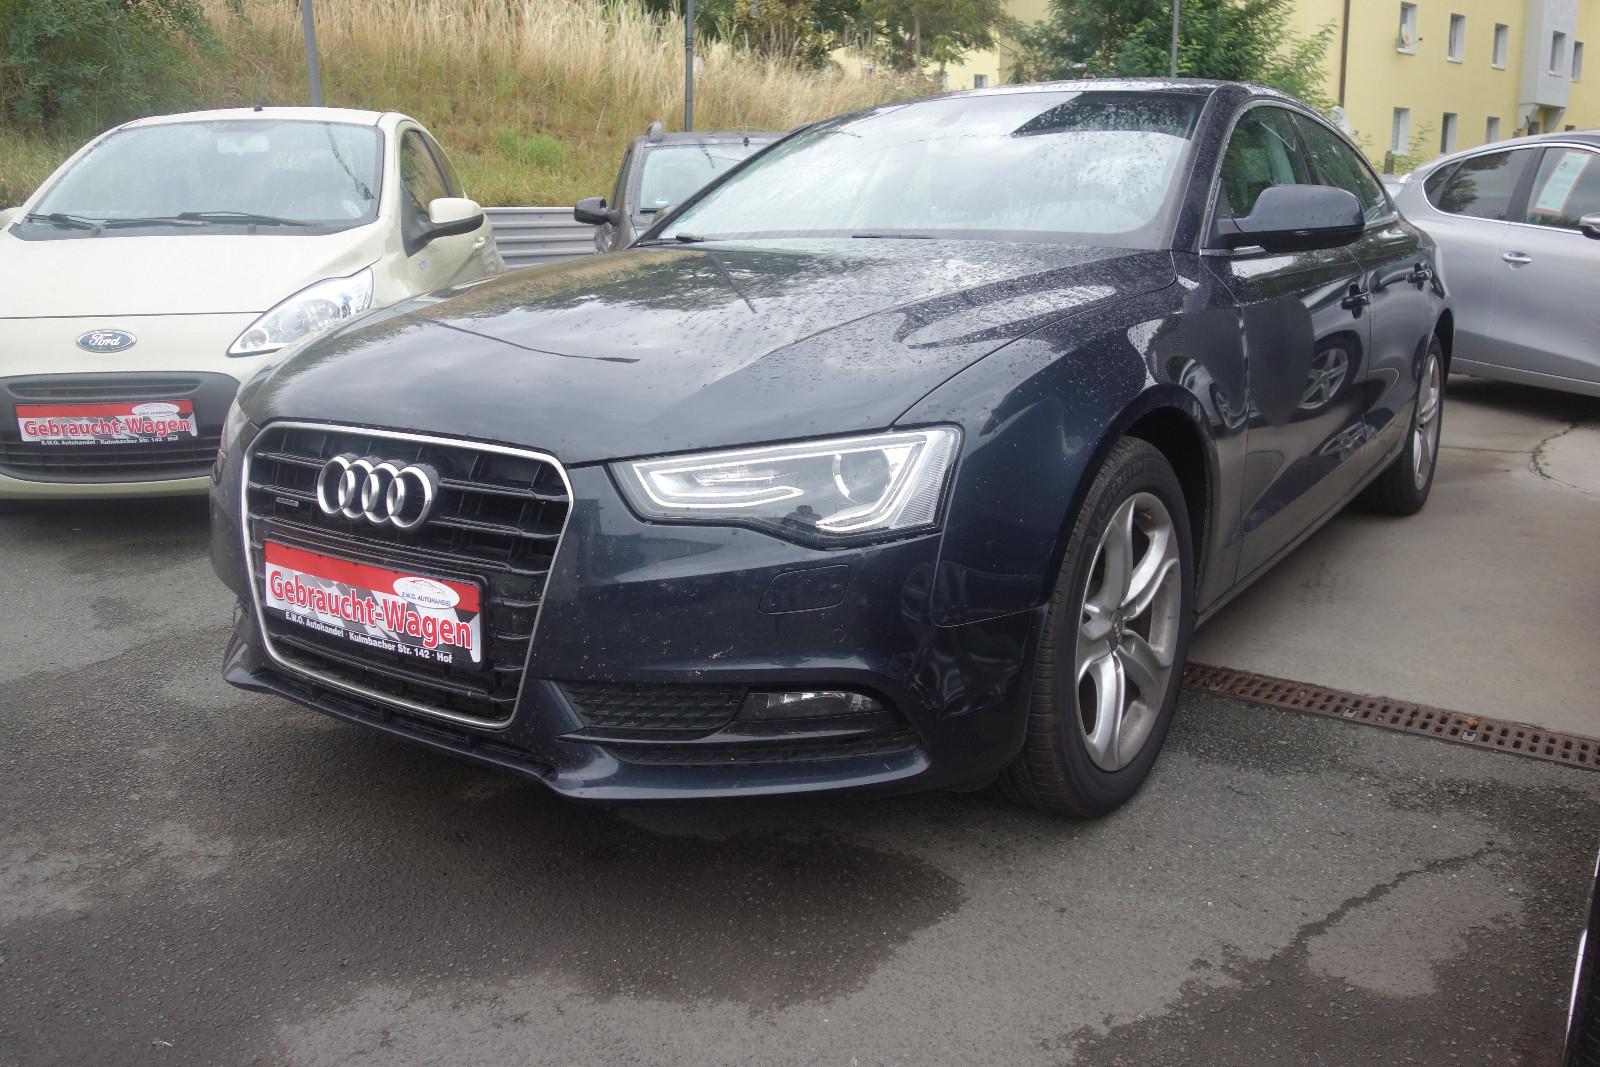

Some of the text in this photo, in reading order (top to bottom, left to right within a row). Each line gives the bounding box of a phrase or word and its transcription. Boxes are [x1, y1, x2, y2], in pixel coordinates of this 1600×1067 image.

[89, 333, 121, 346] Ford
[23, 417, 191, 437] Gebraucht-Wagen
[269, 569, 473, 650] Gebraucht-Wagen
[285, 611, 453, 664] E.W.O. Autohandel Kulmbacher Str. 142 Hof
